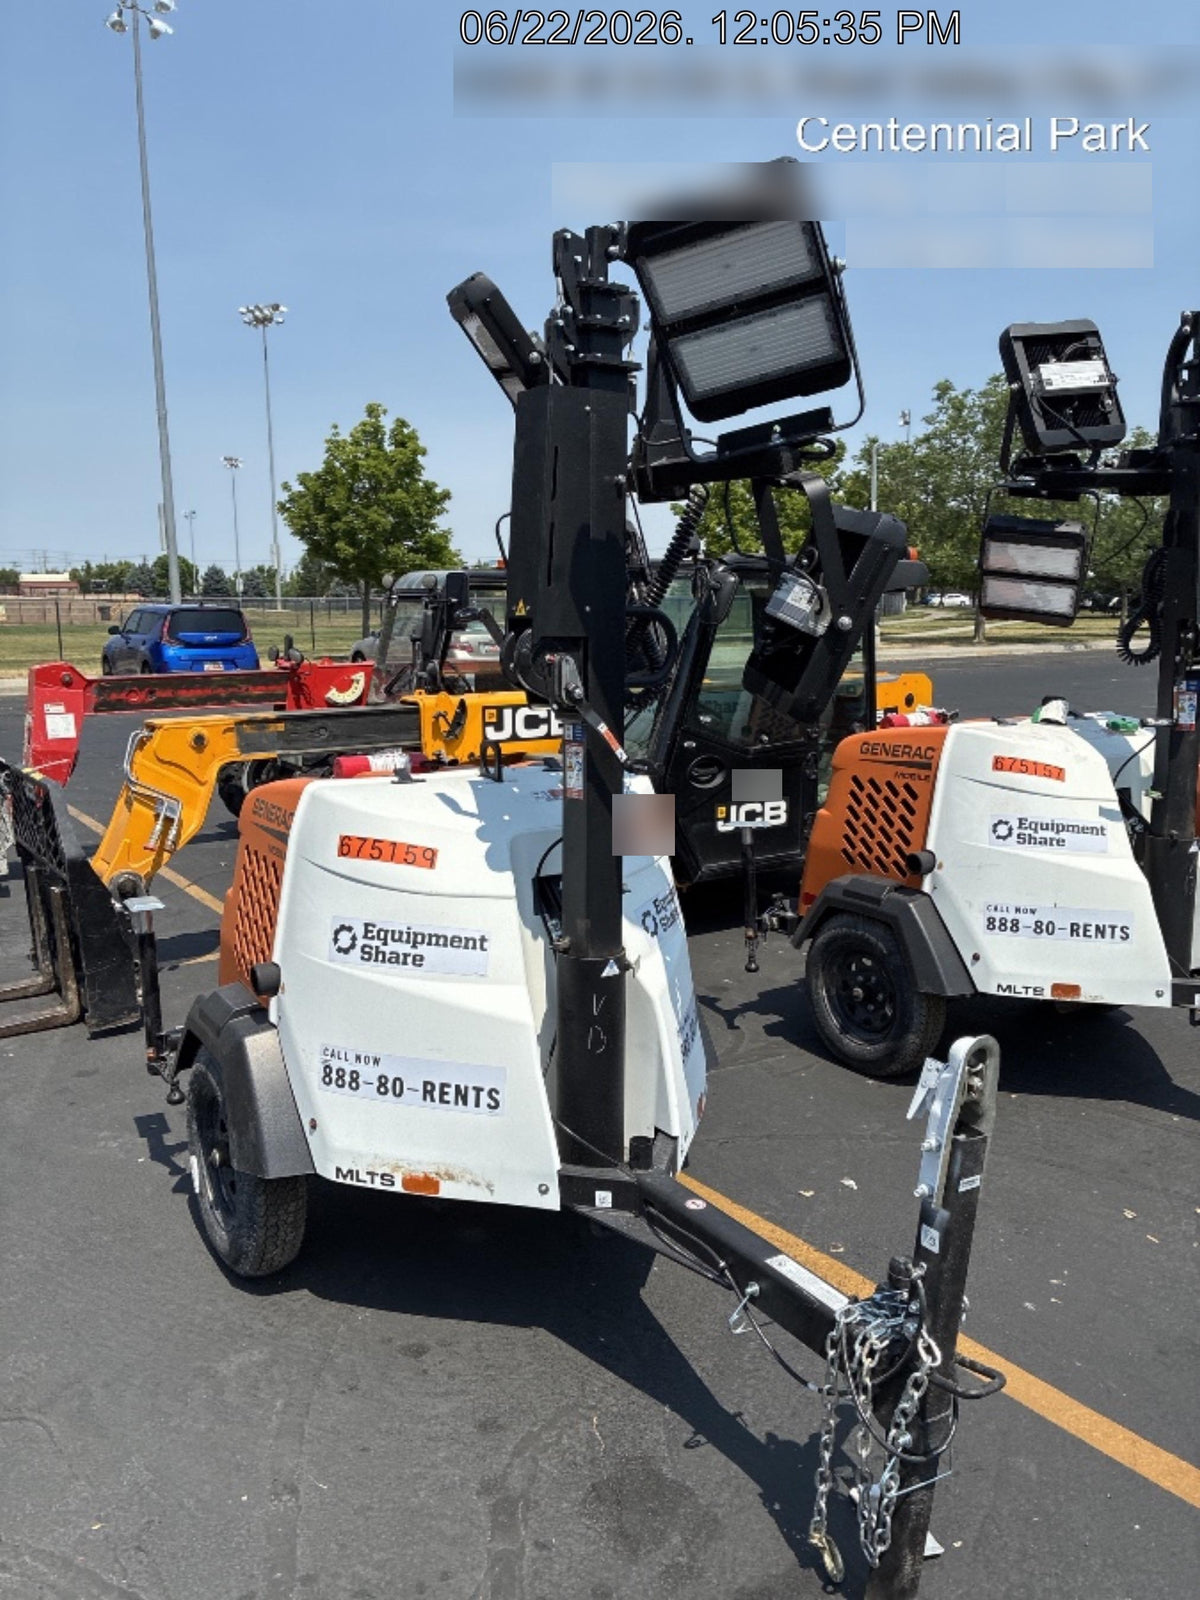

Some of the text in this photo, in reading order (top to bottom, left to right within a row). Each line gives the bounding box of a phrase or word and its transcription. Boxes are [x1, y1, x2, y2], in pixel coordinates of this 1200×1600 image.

[859, 741, 936, 760] GENERAC
[994, 756, 1063, 780] 675157
[716, 800, 787, 832] JCB
[1016, 817, 1107, 836] Equipment
[340, 835, 436, 868] 675159
[1016, 832, 1066, 847] Share
[362, 922, 488, 951] Equipment
[986, 916, 1130, 942] 888-80-RENTS
[360, 943, 425, 968] Share
[322, 1046, 381, 1067] CALL NOW
[321, 1063, 500, 1110] 888-80-RENTS
[335, 1165, 395, 1187] MLTS
